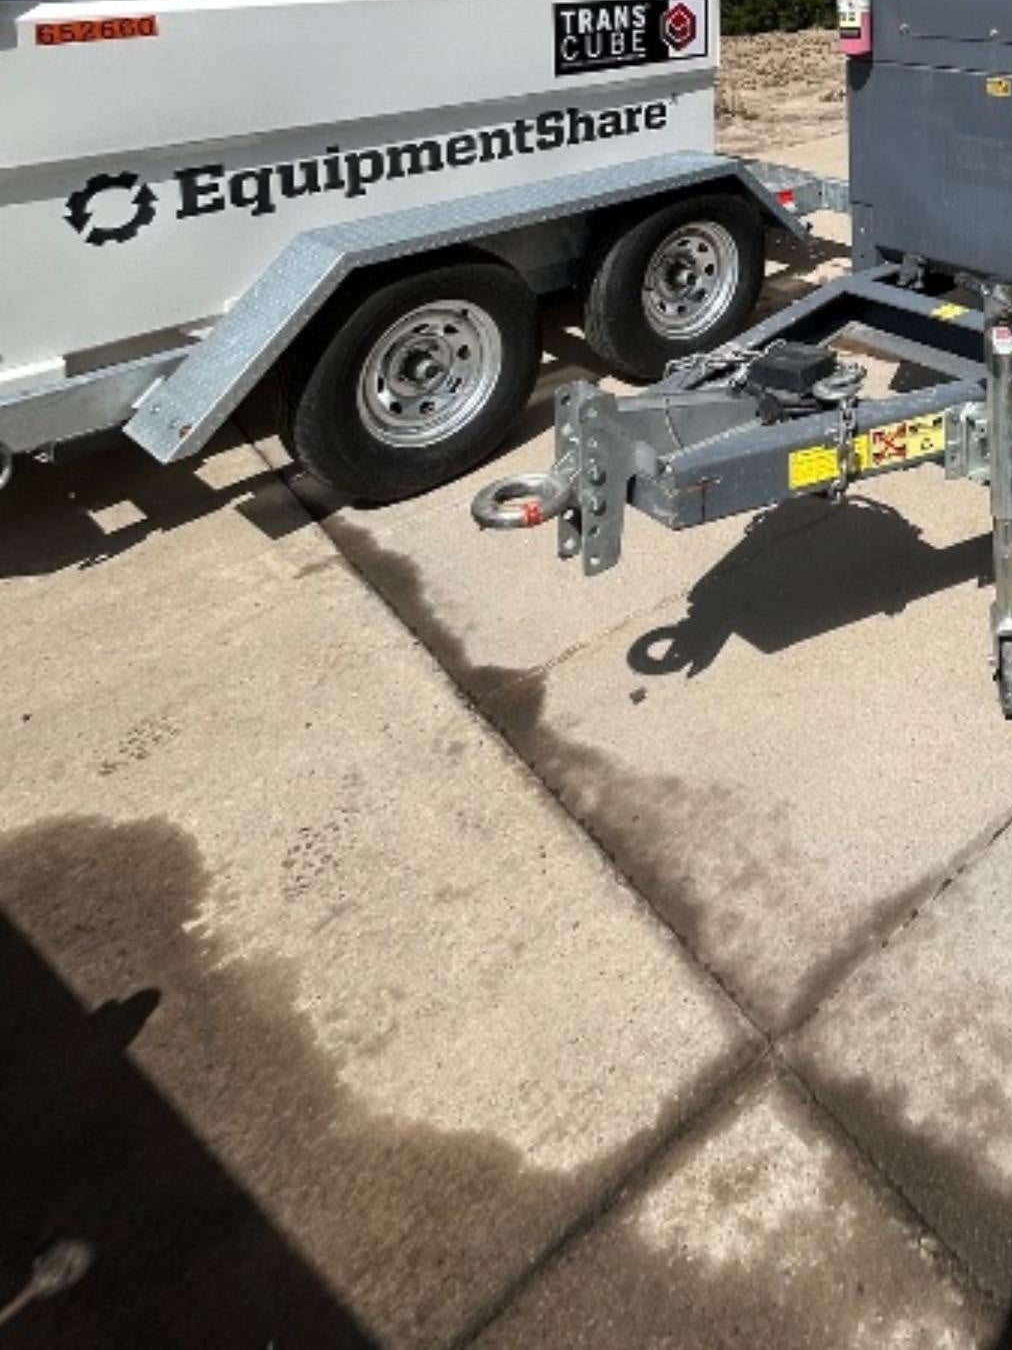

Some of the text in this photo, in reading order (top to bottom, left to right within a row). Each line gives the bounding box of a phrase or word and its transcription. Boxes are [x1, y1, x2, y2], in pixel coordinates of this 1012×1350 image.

[560, 5, 646, 34] TRANS
[560, 29, 646, 61] CUBE
[175, 101, 668, 220] EquipmentShare
